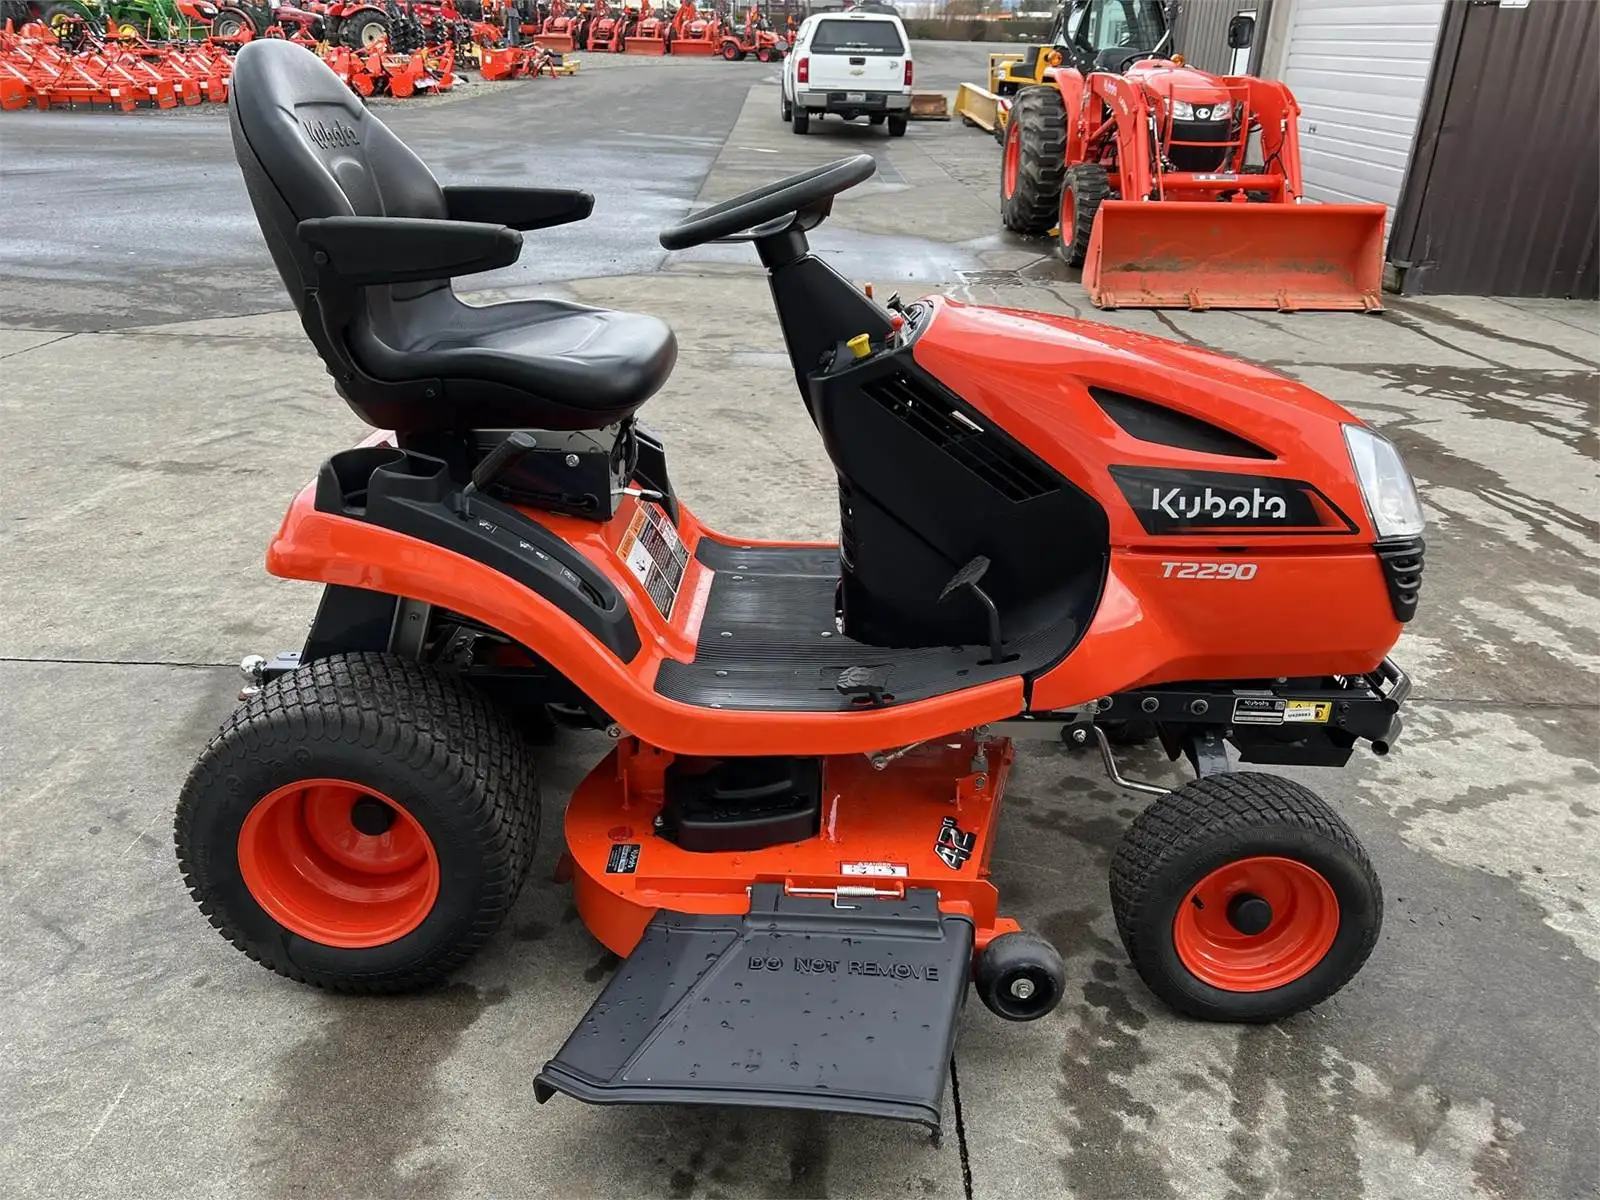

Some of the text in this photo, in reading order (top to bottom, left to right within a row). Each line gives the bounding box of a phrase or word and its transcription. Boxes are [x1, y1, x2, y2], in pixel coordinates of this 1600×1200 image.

[302, 119, 360, 149] Kubota
[1152, 487, 1286, 518] Kubota
[1160, 561, 1258, 580] T2290
[748, 956, 940, 982] DO NOT REMOVE
